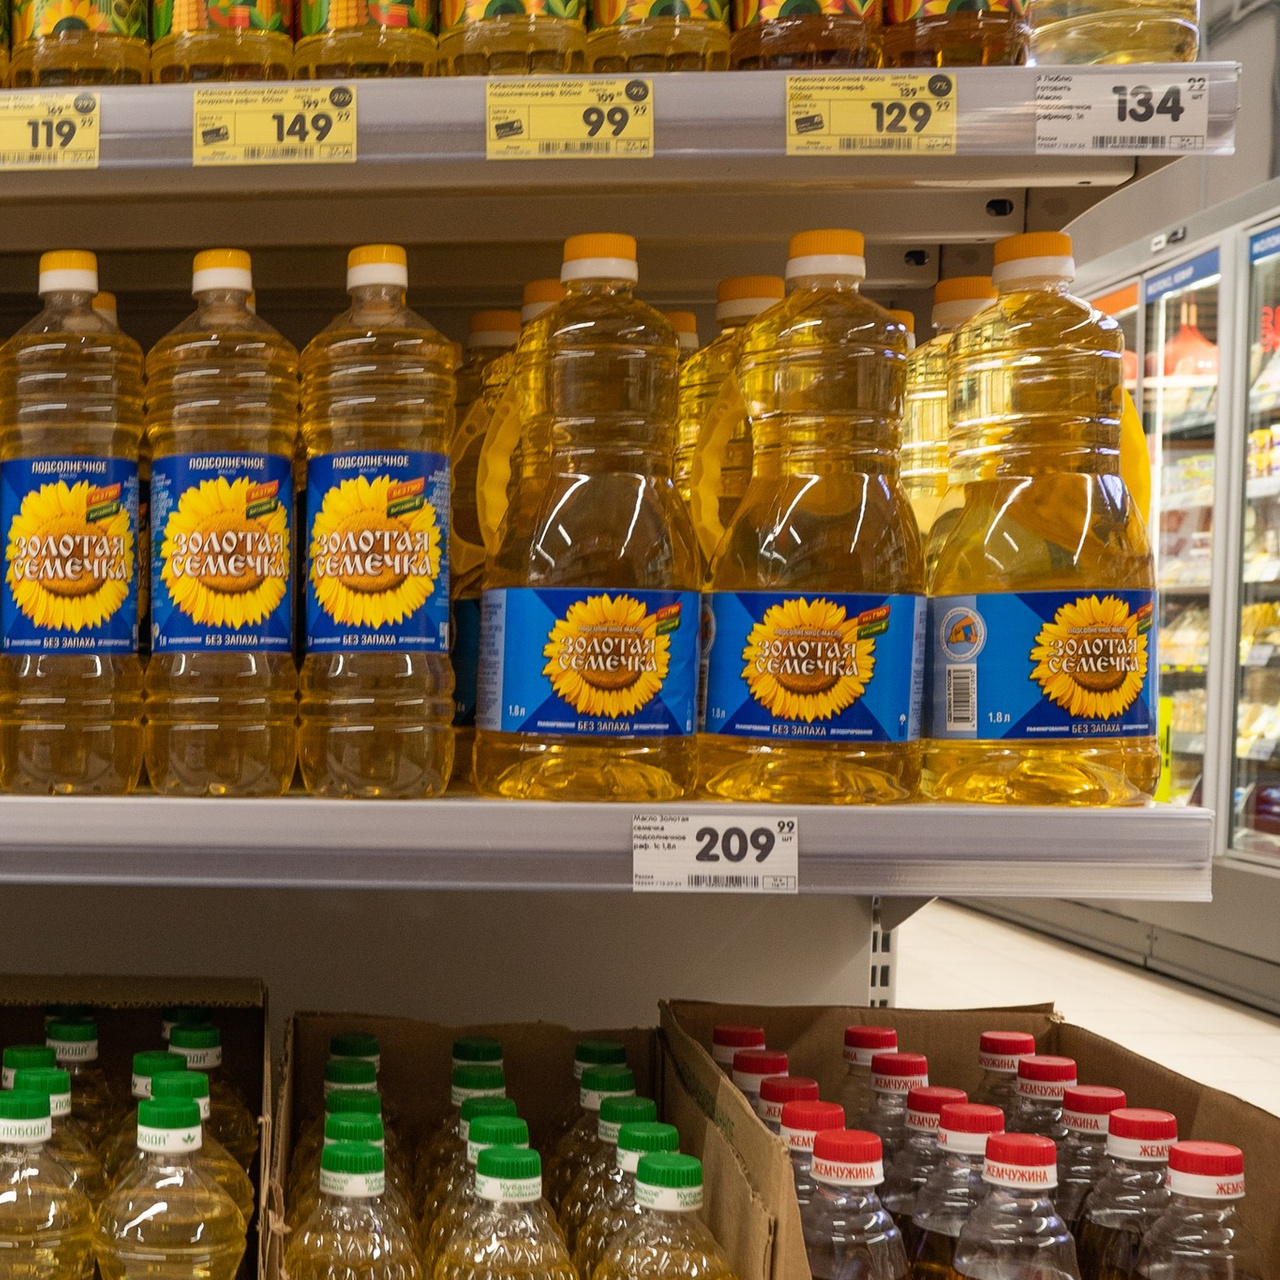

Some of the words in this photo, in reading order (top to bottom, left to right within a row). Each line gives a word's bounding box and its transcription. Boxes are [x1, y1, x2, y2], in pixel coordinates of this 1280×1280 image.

[1112, 85, 1185, 122] 134
[582, 106, 629, 137] 99
[871, 101, 932, 133] 129
[27, 119, 77, 148] 119
[271, 112, 333, 142] 149
[172, 531, 285, 555] ЗОЛОТАЯ
[316, 530, 429, 554] ЗОЛОТАЯ
[172, 554, 286, 578] СЕМЕЧКА
[316, 554, 432, 577] СЕМЕЧКА
[205, 634, 223, 645] БЕЗ
[225, 635, 258, 646] ЗАПАХА
[343, 634, 360, 645] БЕЗ
[362, 634, 396, 646] ЗАПАХА
[559, 636, 656, 654] ЗОЛОТАЯ
[756, 640, 857, 658] ЗОЛОТАЯ
[1048, 638, 1138, 656] ЗОЛОТАЯ
[559, 654, 657, 671] СЕМЕЧКА
[755, 659, 859, 676] СЕМЕЧКА
[1047, 656, 1139, 673] СЕМЕЧКА
[578, 721, 595, 731] БЕЗ
[596, 721, 630, 732] ЗАПАХА
[772, 724, 789, 735] БЕЗ
[791, 725, 827, 736] ЗАПАХА
[1072, 723, 1089, 733] БЕЗ
[1091, 723, 1120, 733] ЗАПАХА
[695, 826, 776, 863] 209
[777, 820, 795, 833] 99
[812, 1162, 876, 1181] ЖЕМЧУЖИНА
[986, 1164, 1049, 1183] ЖЕМЧУЖИНА
